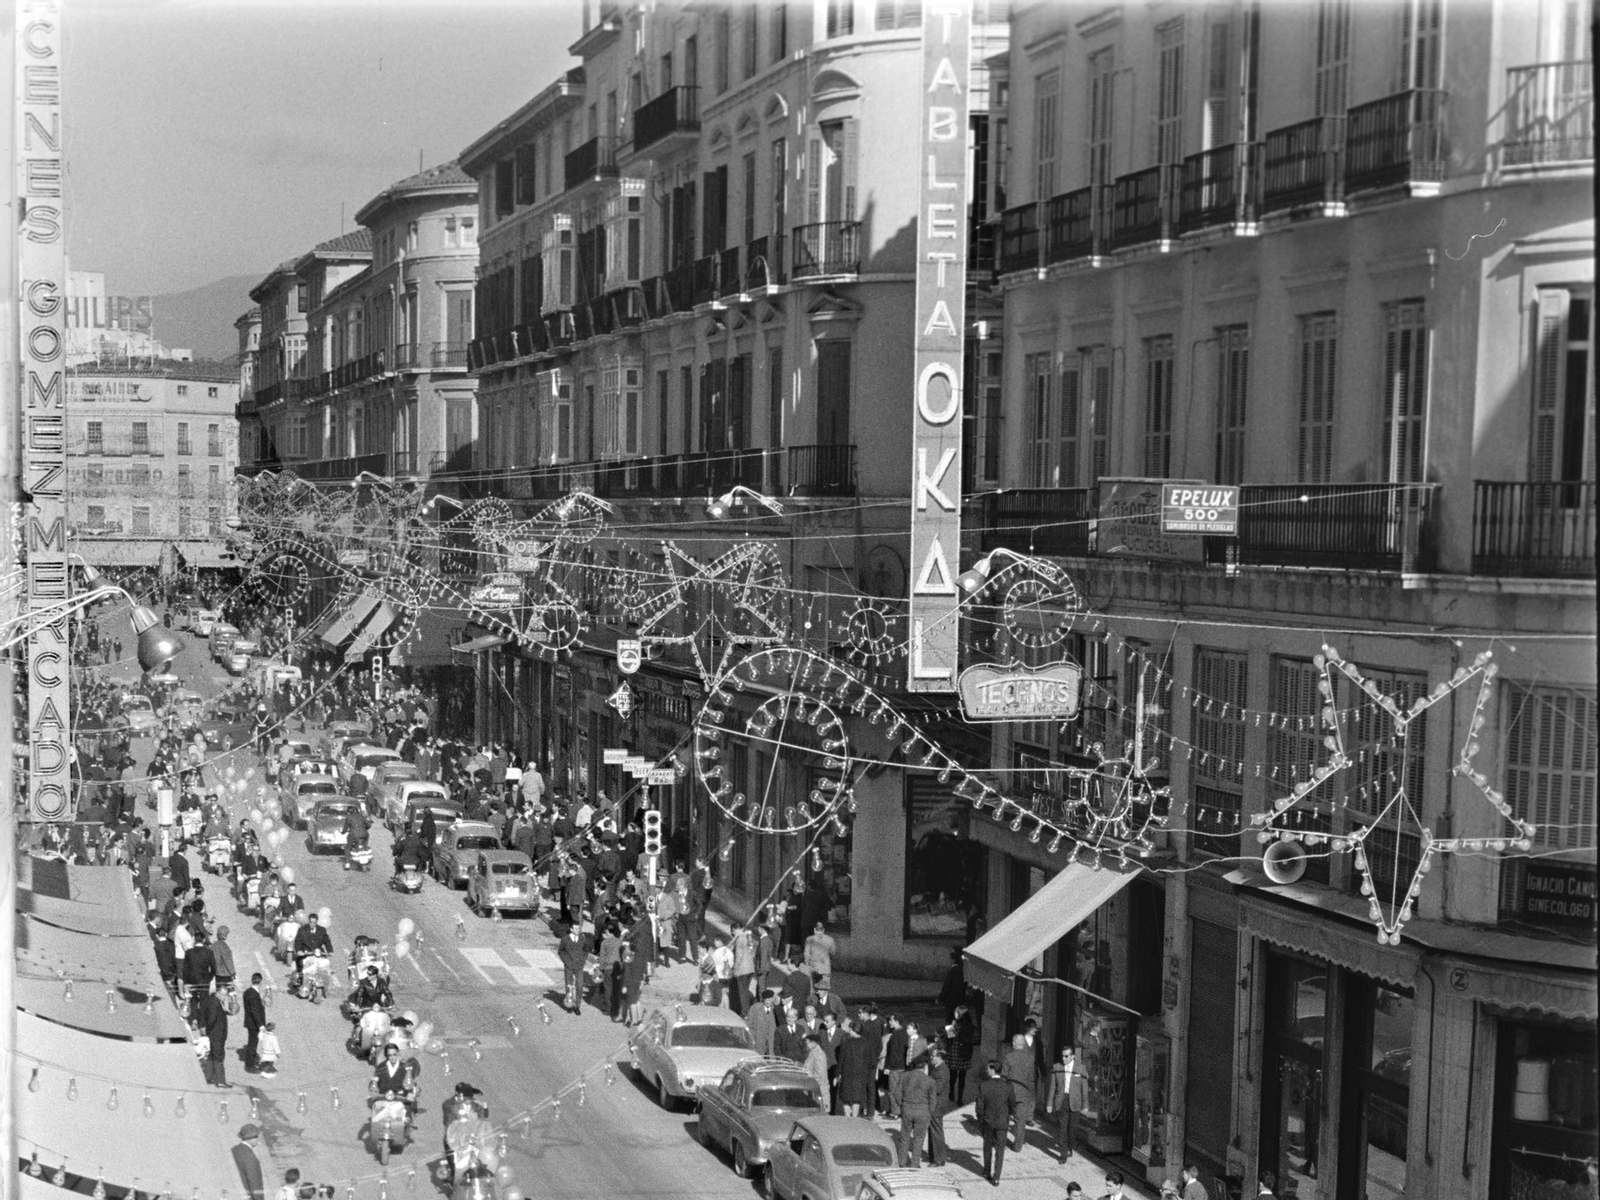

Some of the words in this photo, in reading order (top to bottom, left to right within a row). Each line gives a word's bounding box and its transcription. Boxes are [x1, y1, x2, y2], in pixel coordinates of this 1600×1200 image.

[23, 0, 61, 244] CENES
[923, 8, 962, 336] TABLETA
[65, 295, 153, 329] HILIPS
[28, 278, 65, 500] GOMEZ
[1170, 489, 1233, 507] EPELUX
[913, 361, 958, 679] OKAL
[1166, 522, 1198, 531] LUMINOSOS
[1199, 523, 1206, 531] DE
[1207, 523, 1234, 532] PLEXIGLAS
[1121, 536, 1178, 555] SUCURSAL
[30, 516, 68, 818] MERCADO
[976, 676, 1069, 704] TECHNOS
[1526, 872, 1565, 893] IGNACIO
[1528, 898, 1590, 918] GINECOLOGO
